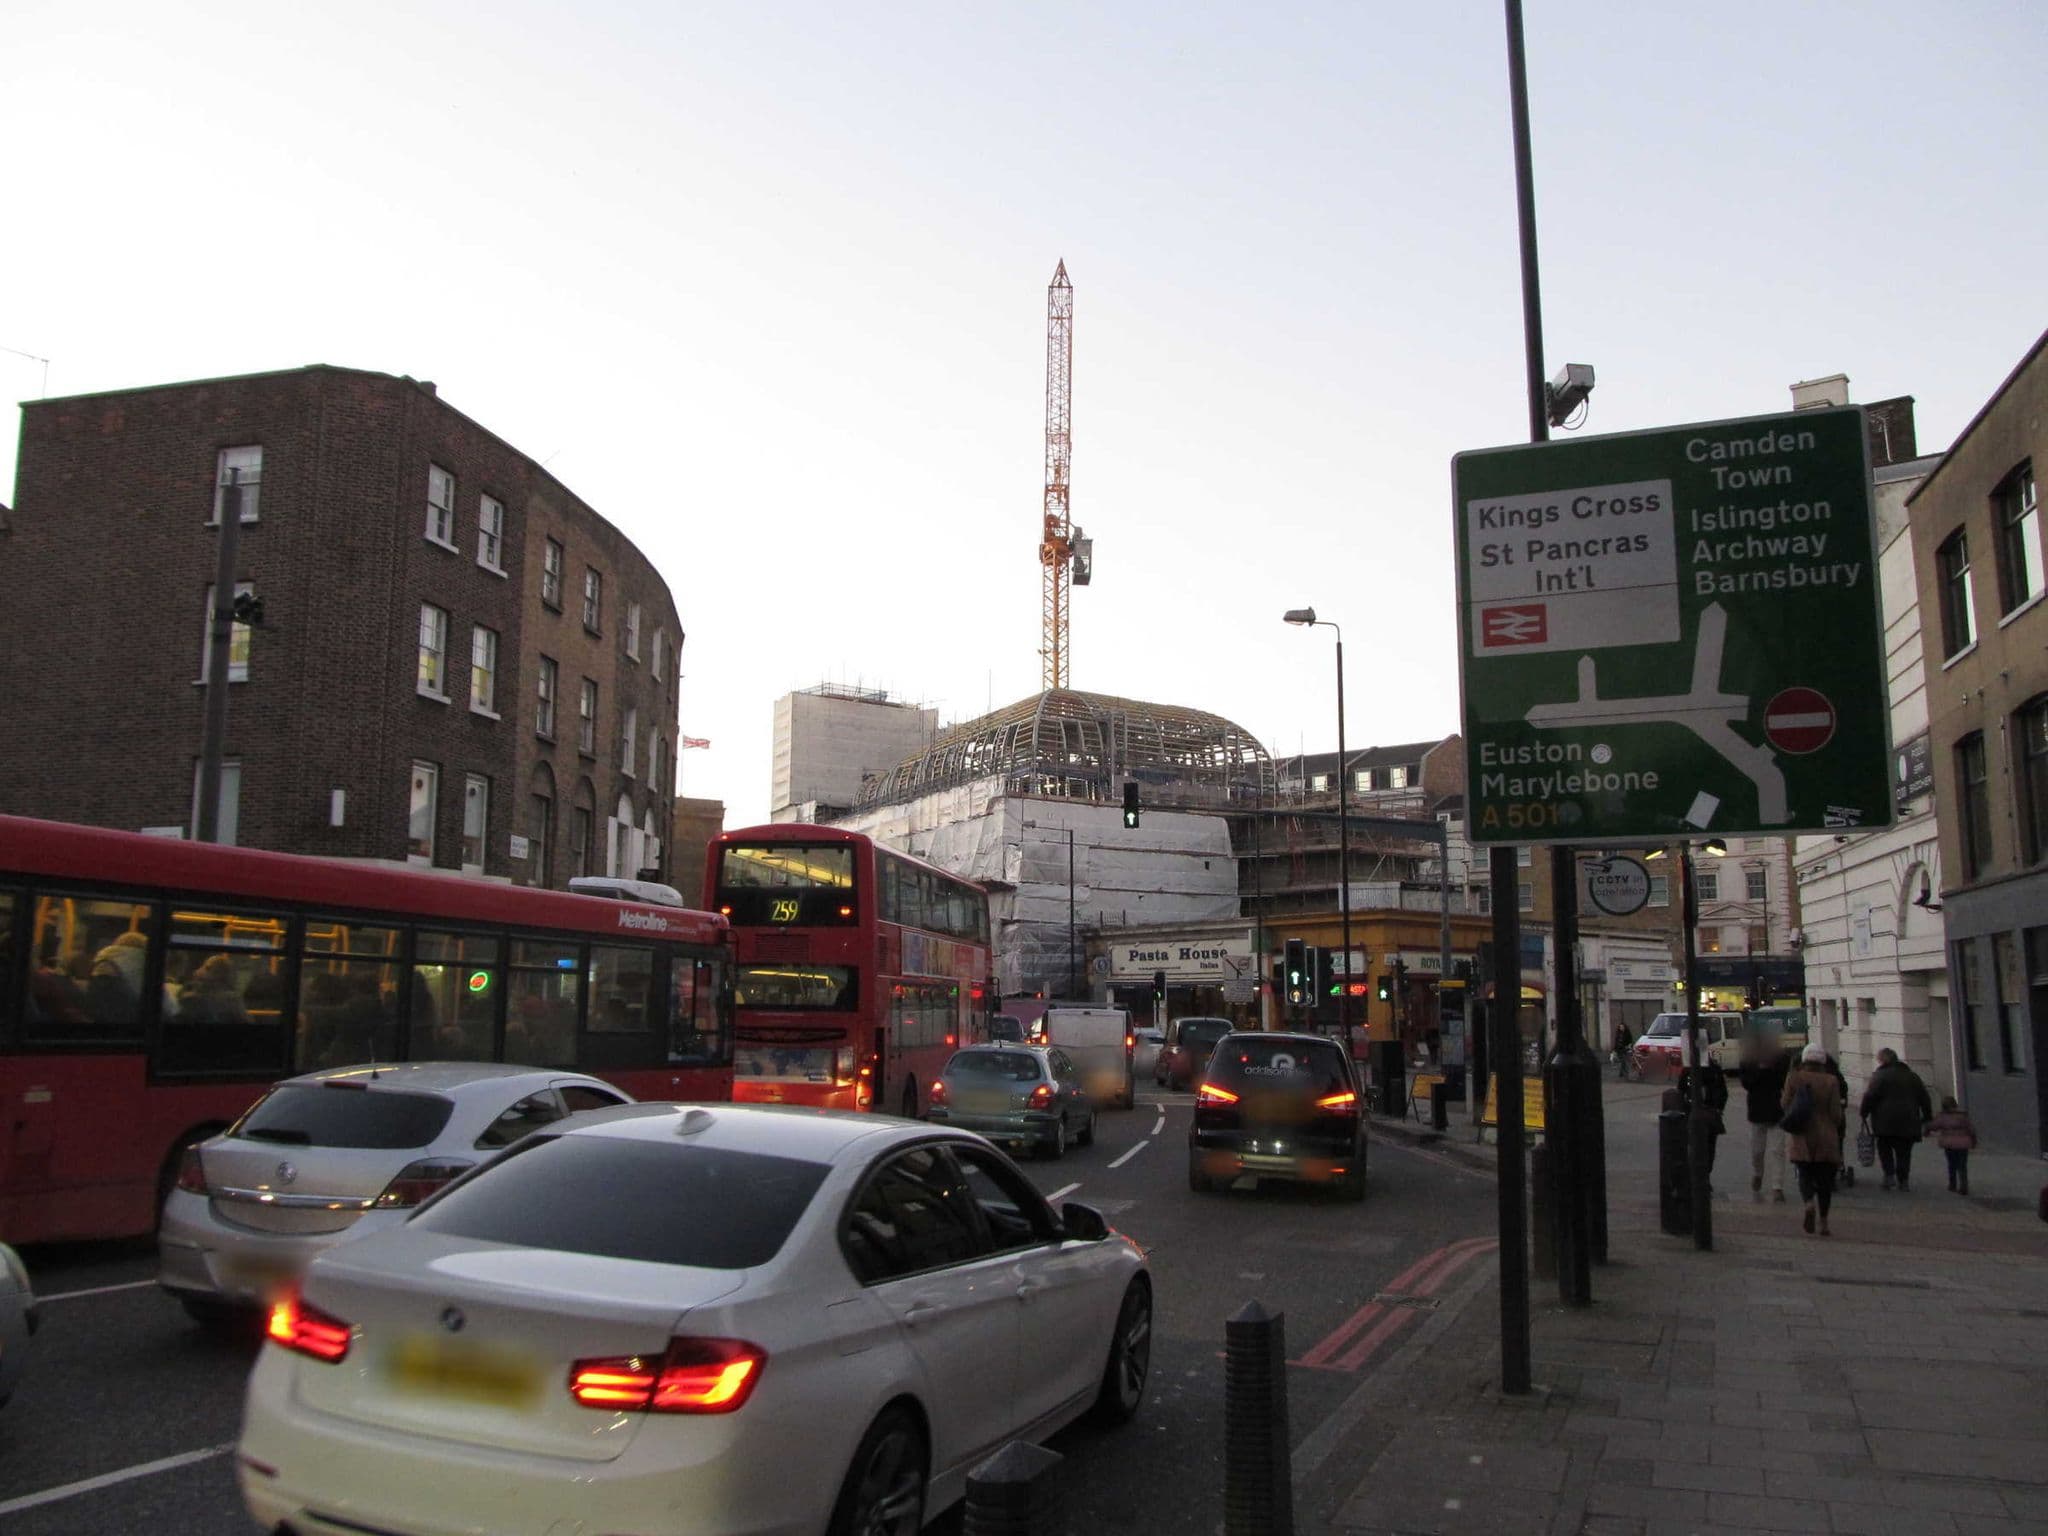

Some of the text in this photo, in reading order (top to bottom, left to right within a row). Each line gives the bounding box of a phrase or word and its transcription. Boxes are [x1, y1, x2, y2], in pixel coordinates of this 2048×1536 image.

[1686, 430, 1815, 462] Camden
[1710, 465, 1792, 490] Town
[1479, 494, 1660, 529] Kings Cross
[1691, 500, 1832, 532] Islington
[1480, 533, 1649, 567] St Pancras
[1692, 533, 1828, 564] Archway
[1536, 564, 1596, 593] Int'l
[1695, 562, 1861, 595] Barnsbury
[1480, 740, 1582, 766] Euston
[1481, 769, 1659, 799] Marylebone
[1597, 875, 1630, 884] CCTV
[618, 909, 668, 932] Metroline
[771, 900, 799, 922] 259
[1129, 947, 1228, 961] Pasta House
